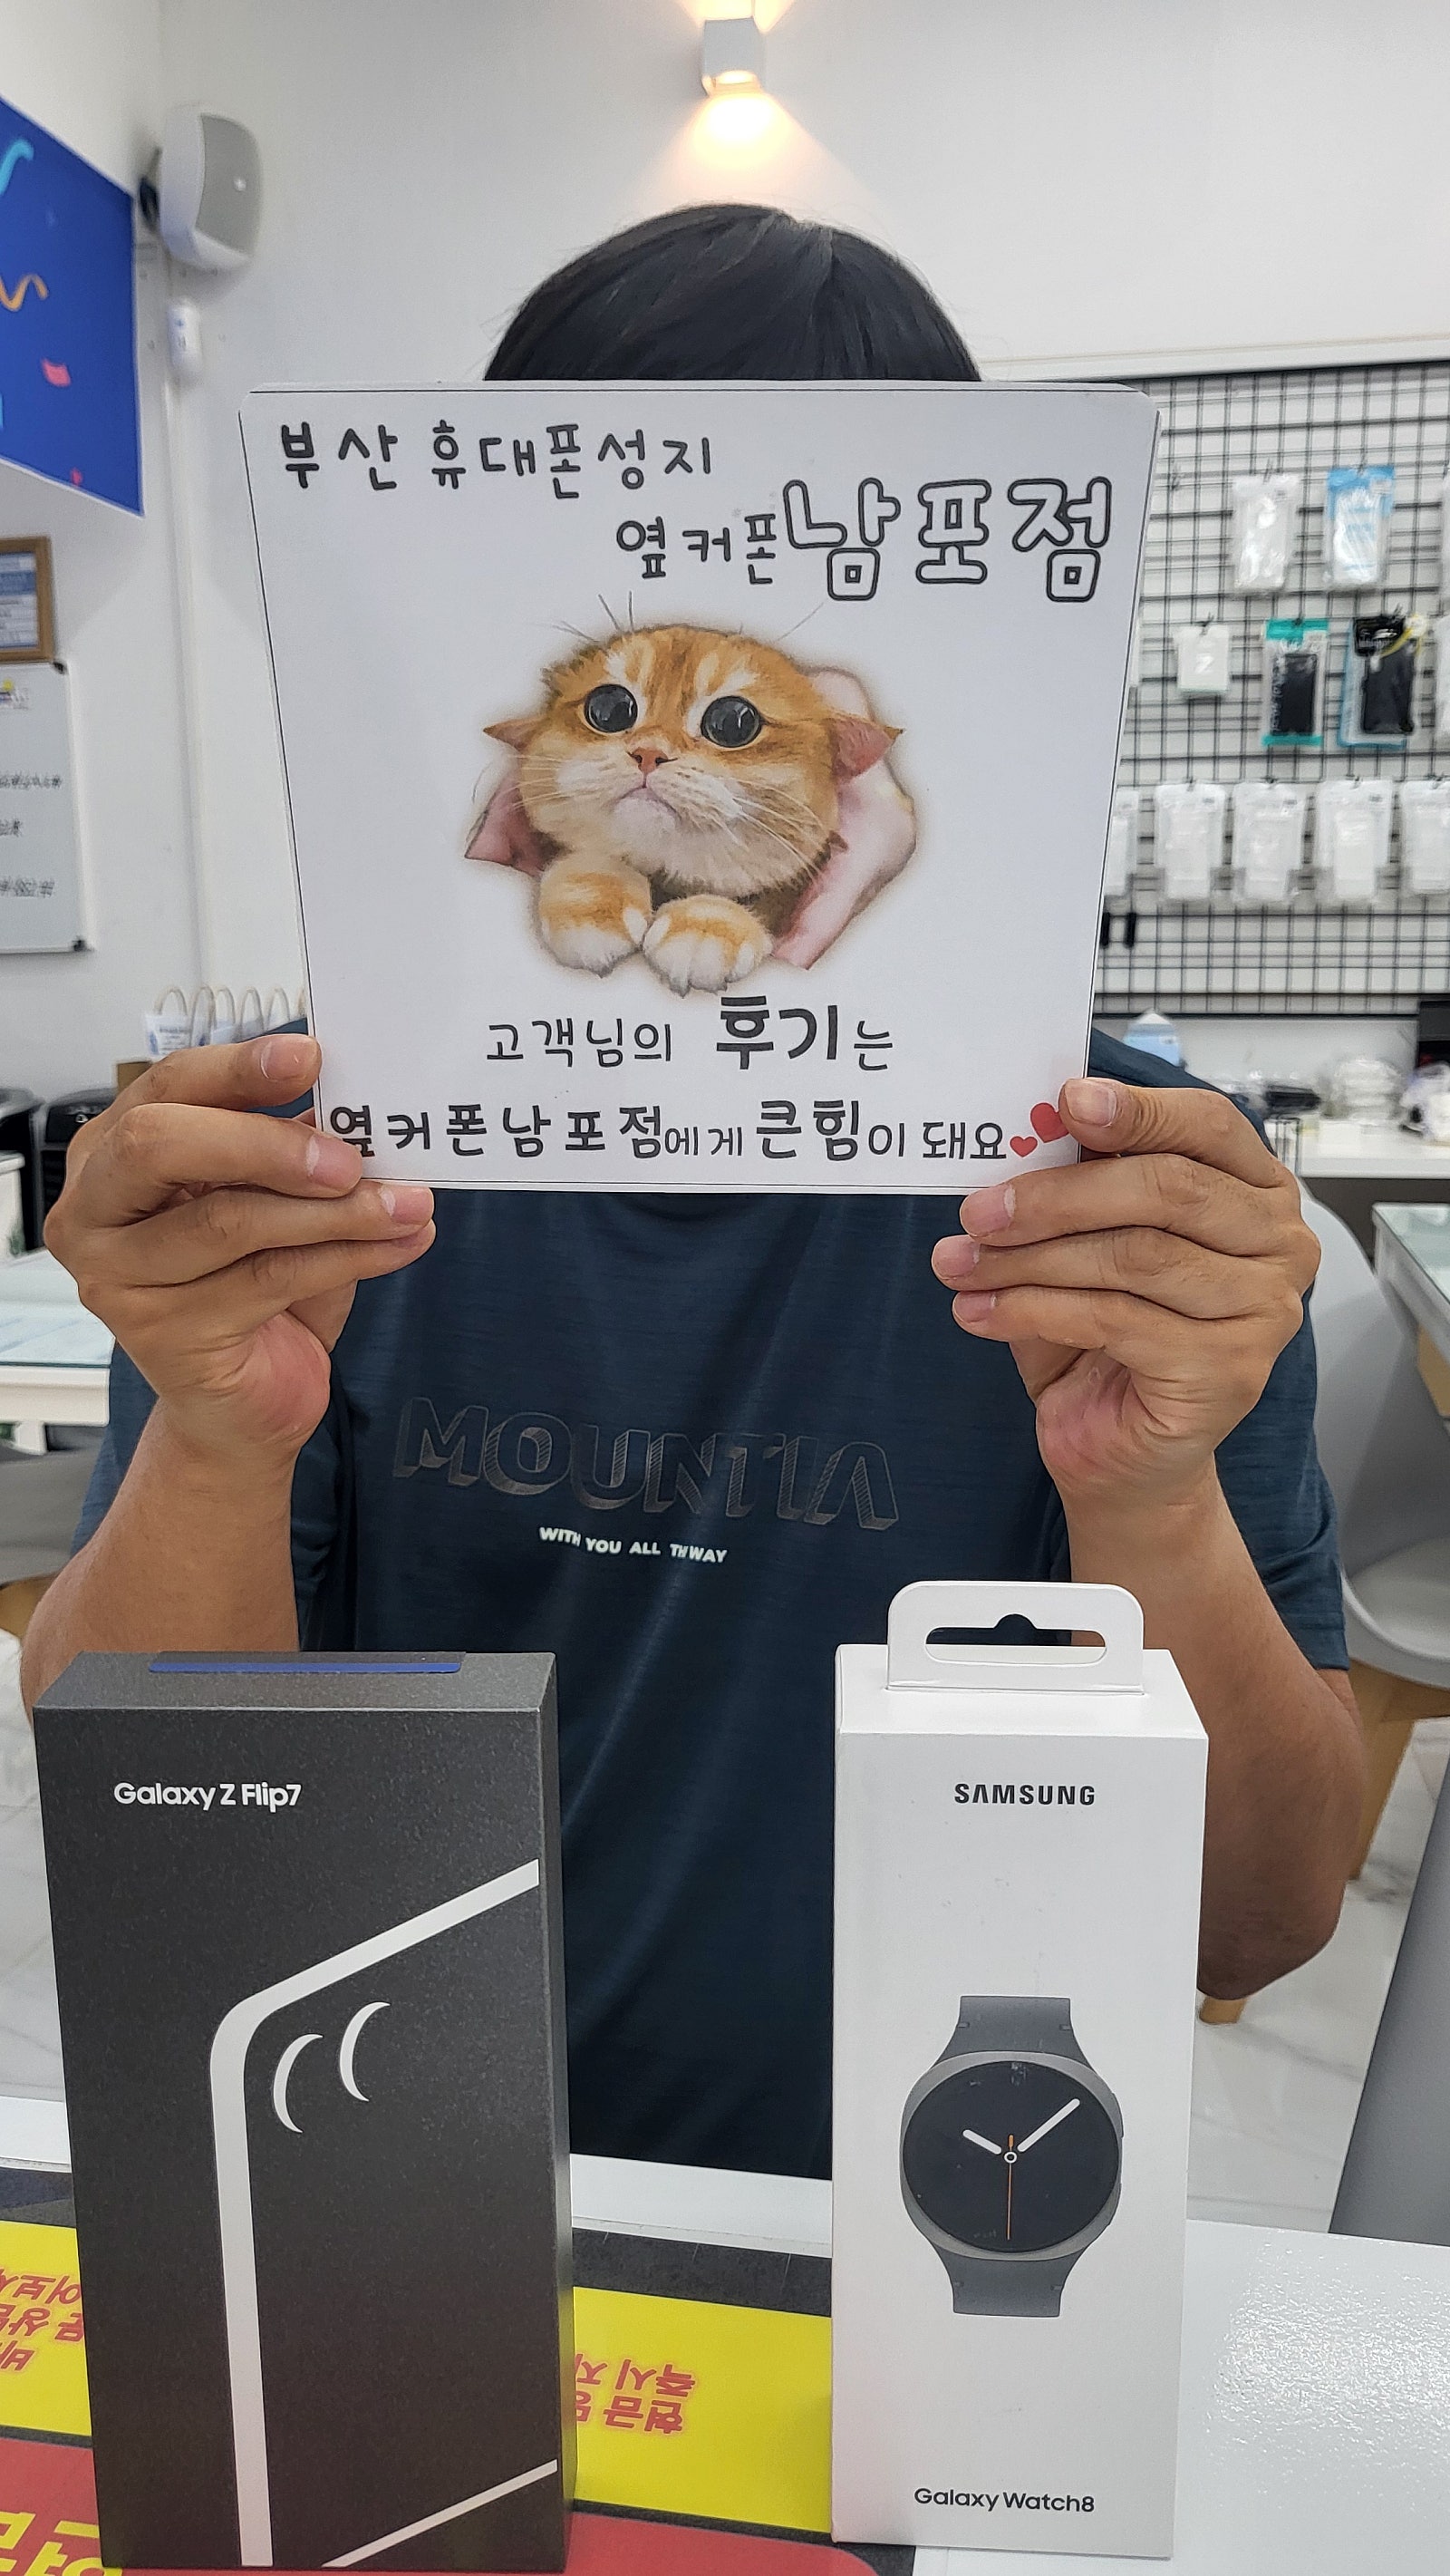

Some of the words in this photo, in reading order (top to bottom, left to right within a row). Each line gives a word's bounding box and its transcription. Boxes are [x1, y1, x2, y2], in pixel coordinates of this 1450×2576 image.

[281, 421, 399, 489] 부산
[430, 420, 712, 499] 휴대폰성지
[782, 476, 1113, 603] 남포점
[486, 1017, 672, 1069] 고객님의
[716, 994, 894, 1071] 후기는
[922, 1121, 1008, 1160] 돼요
[392, 1396, 900, 1531] MOUNTIA
[538, 1526, 582, 1547] WITH
[585, 1537, 623, 1554] YOU
[629, 1541, 662, 1555] ALL
[113, 1782, 217, 1812] Galaxy
[219, 1783, 237, 1806] Z
[241, 1781, 302, 1813] Flip7
[953, 1782, 1096, 1806] SAMSUNG
[614, 2359, 696, 2397] 즉시
[602, 2396, 683, 2436] 현금
[914, 2487, 1000, 2513] Galaxy
[1002, 2491, 1096, 2513] Watch8
